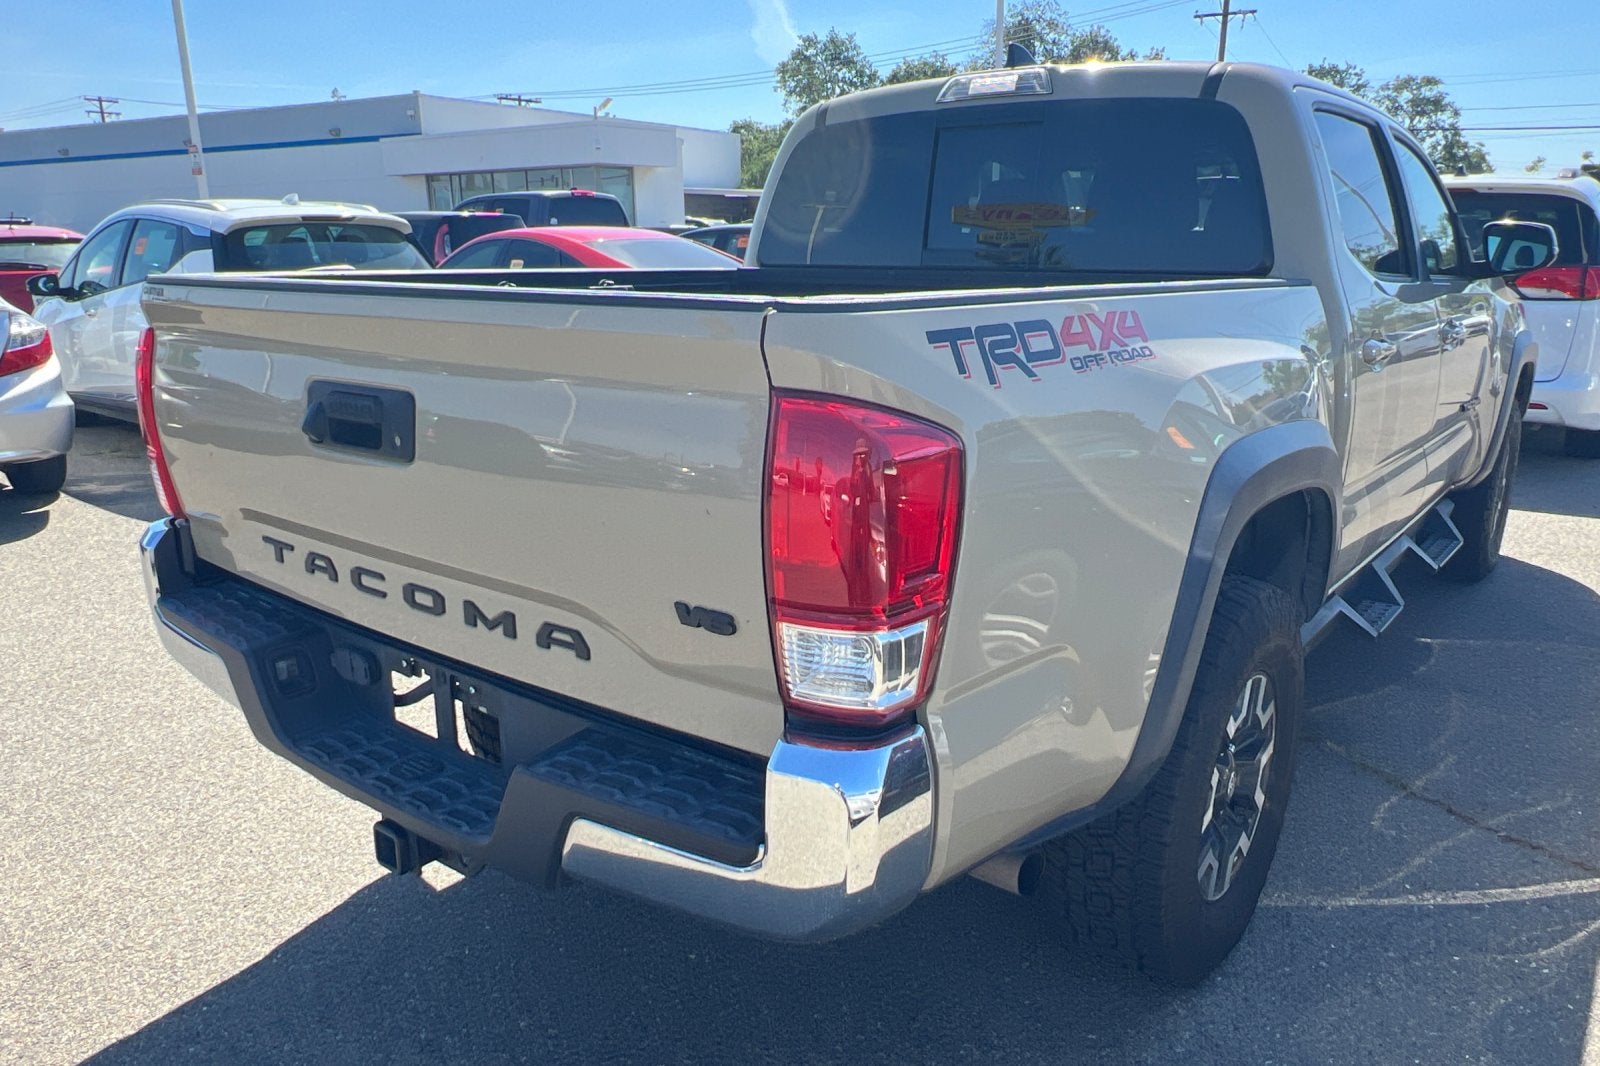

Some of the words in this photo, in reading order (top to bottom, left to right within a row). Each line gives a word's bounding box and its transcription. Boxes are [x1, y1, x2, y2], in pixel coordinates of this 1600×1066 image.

[1070, 353, 1107, 372] OFF
[1107, 346, 1155, 366] ROAD
[262, 535, 591, 661] TACOMA
[674, 601, 737, 636] V6
